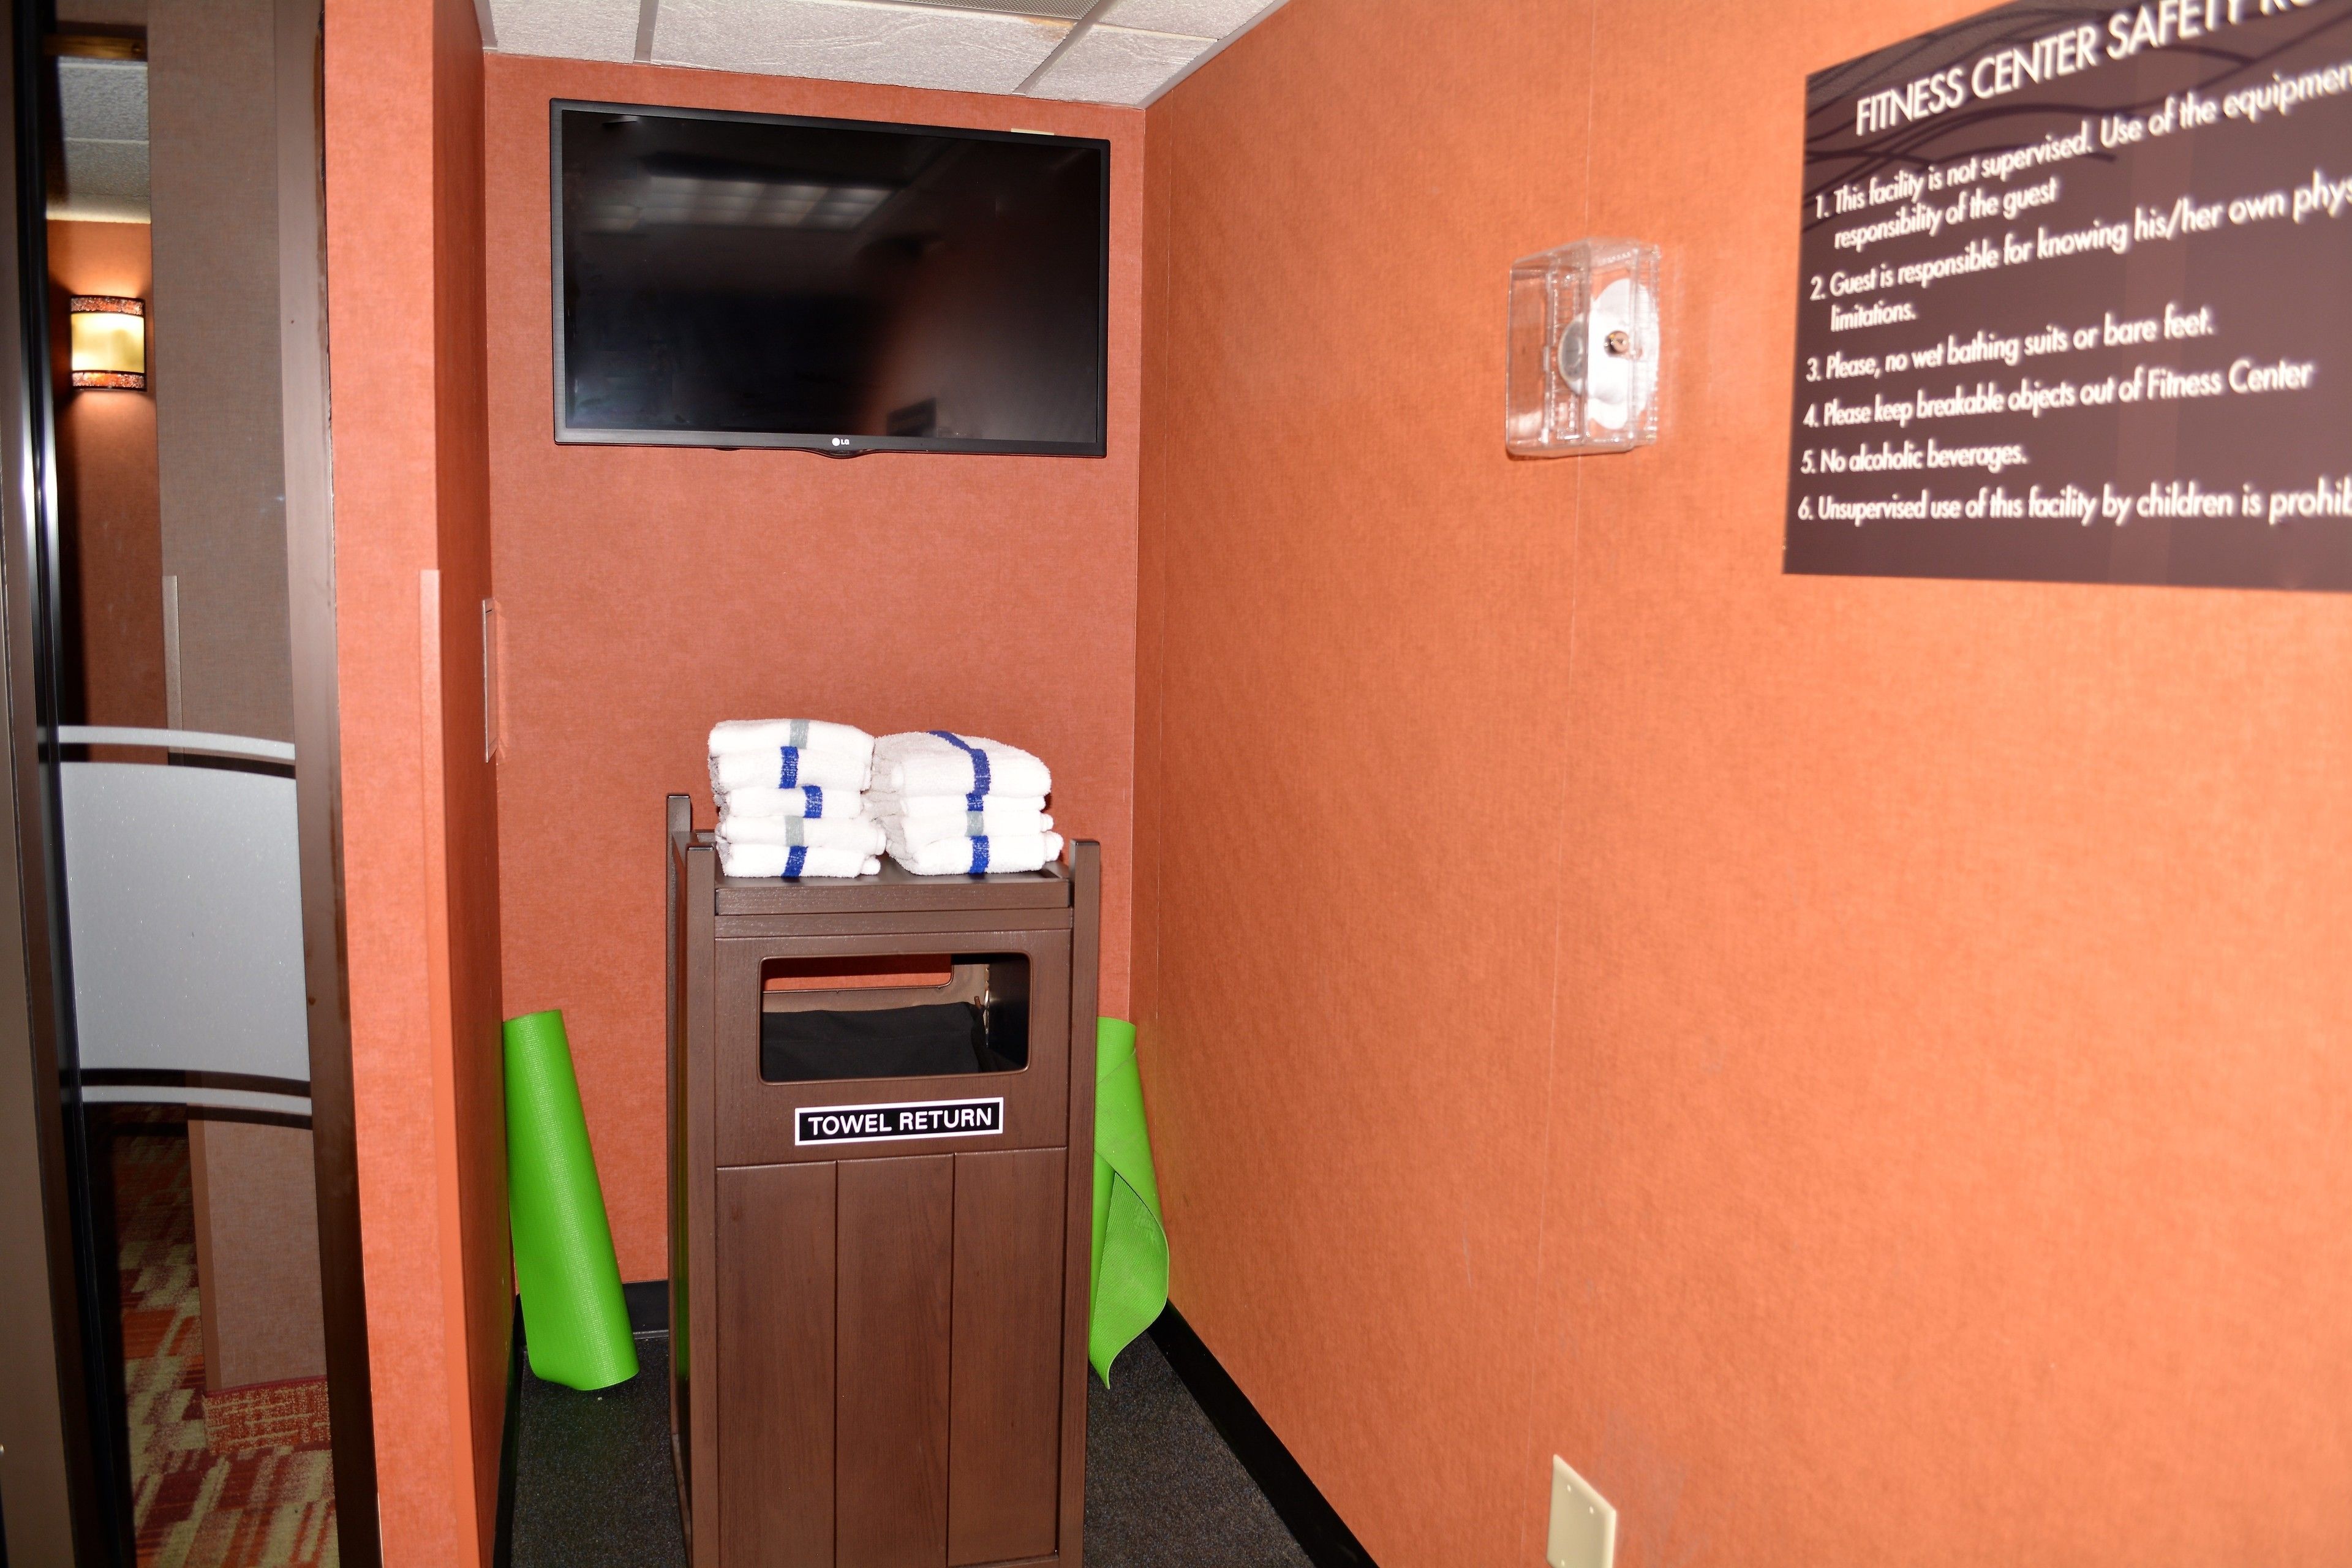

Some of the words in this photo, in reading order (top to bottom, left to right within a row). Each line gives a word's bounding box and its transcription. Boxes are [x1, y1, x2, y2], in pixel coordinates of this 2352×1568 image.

[1855, 69, 1964, 136] FITNESS
[1971, 26, 2097, 99] CENTER
[1815, 195, 1830, 219] 1.
[1834, 186, 1866, 214] This
[1869, 169, 1924, 203] facility
[1928, 165, 1943, 191] is
[1947, 157, 1977, 187] not
[1981, 120, 2093, 181] supervised.
[2100, 115, 2141, 149] Use
[2148, 98, 2175, 136] of
[2179, 92, 2215, 129] the
[1811, 276, 1826, 301] 2.
[1830, 273, 1877, 298] Guest
[1880, 265, 1894, 288] is
[1898, 239, 1999, 288] responsible
[2003, 228, 2034, 265] for
[2037, 216, 2128, 260] knowing
[2134, 192, 2222, 239] his/her
[2228, 190, 2285, 224] own
[1834, 202, 1942, 250] responsibility
[1946, 191, 1965, 225] of
[1970, 187, 1999, 219] the
[2003, 178, 2059, 218] guest
[1806, 358, 1822, 383] 3.
[1826, 351, 1880, 380] Please,
[1885, 352, 1907, 374] no
[1912, 342, 1943, 370] wet
[1947, 329, 2019, 366] bathing
[2024, 325, 2068, 356] suits
[2073, 326, 2098, 349] or
[2104, 312, 2157, 347] bare
[2163, 303, 2215, 339] feet.
[1830, 302, 1917, 333] limitations.
[1803, 402, 1819, 428] 4.
[1823, 396, 1871, 426] Please
[1874, 391, 1912, 427] keep
[1917, 381, 2004, 420] breakable
[2007, 378, 2075, 418] objects
[2080, 373, 2114, 405] out
[2118, 366, 2144, 402] of
[2147, 364, 2222, 401] Fitness
[2228, 358, 2313, 394] Center
[1801, 448, 1816, 475] 5.
[1820, 450, 1846, 474] No
[1849, 442, 1923, 472] alcoholic
[1927, 438, 2029, 475] beverages.
[1798, 496, 1814, 521] 6.
[1818, 489, 1928, 527] Unsupervised
[1931, 498, 1961, 520] use
[1965, 486, 1988, 520] of
[1989, 487, 2024, 519] this
[2028, 484, 2097, 527] facility
[2102, 483, 2132, 527] by
[2137, 480, 2233, 518] children
[2241, 482, 2263, 517] is
[2269, 475, 2352, 526] prohib
[808, 1114, 892, 1135] TOWEL
[899, 1107, 992, 1131] RETURN
